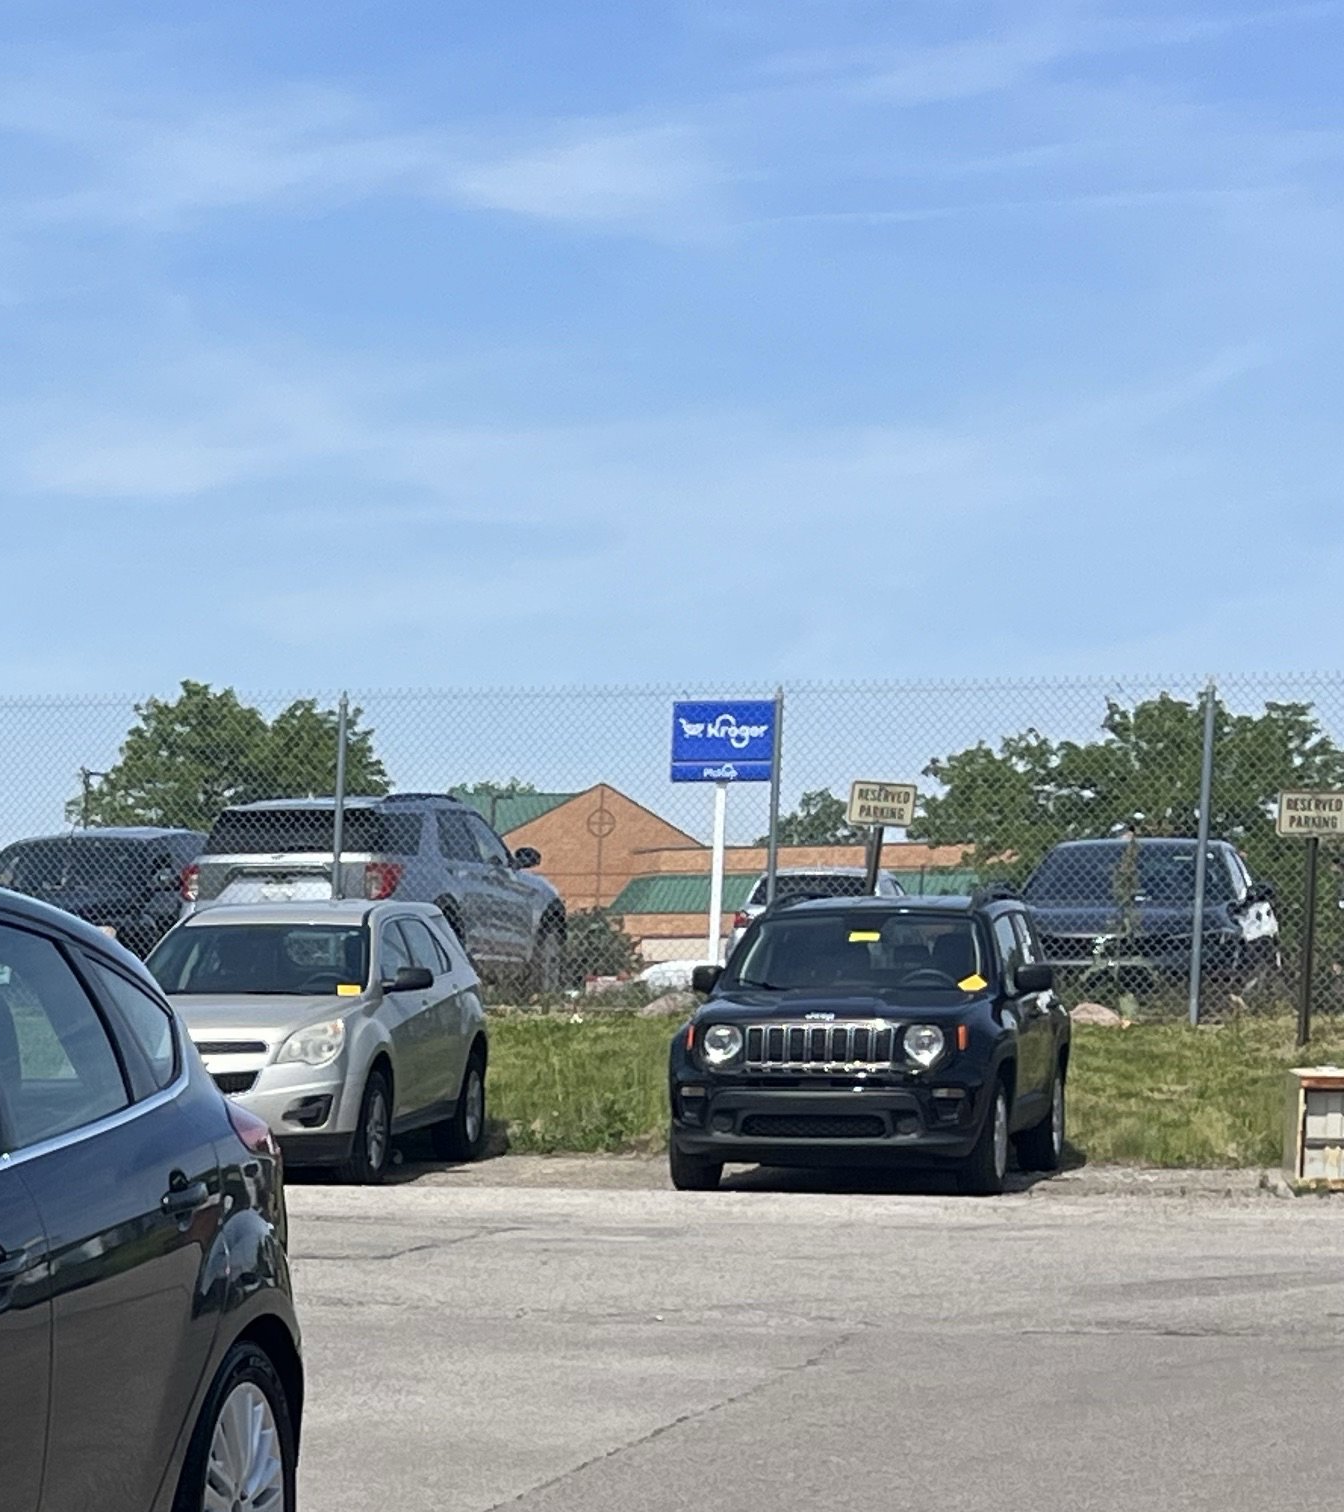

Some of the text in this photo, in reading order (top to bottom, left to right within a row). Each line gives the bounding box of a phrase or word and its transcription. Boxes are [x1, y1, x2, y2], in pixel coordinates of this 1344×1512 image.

[706, 714, 769, 749] Kroger
[857, 788, 911, 805] RESERVED
[858, 804, 905, 820] PARKING
[1286, 798, 1343, 812] RESERVED
[1288, 815, 1338, 829] PARKING
